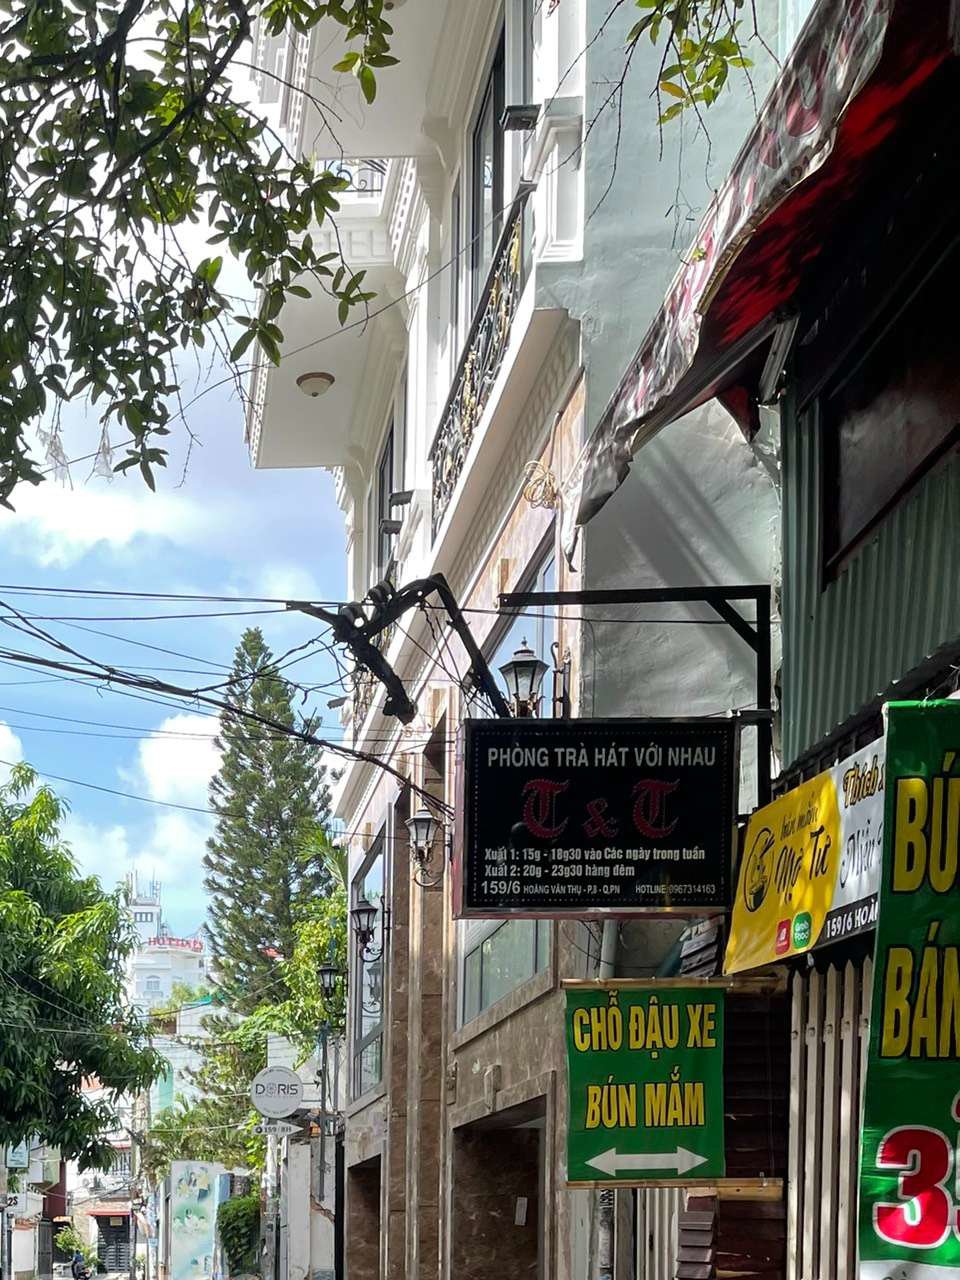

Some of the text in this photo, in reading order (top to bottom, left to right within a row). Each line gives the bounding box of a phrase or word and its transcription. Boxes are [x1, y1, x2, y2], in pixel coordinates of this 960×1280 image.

[487, 742, 716, 768] PHÒNG TRÀ HÁT VỚI NHAU
[582, 798, 619, 838] &
[522, 848, 541, 861] 15g
[551, 848, 582, 861] 18g30
[584, 847, 602, 860] vào
[604, 846, 623, 859] Các
[626, 847, 651, 860] ngày
[653, 848, 680, 860] trong
[682, 845, 705, 860] tuần
[523, 865, 542, 878] 20g
[551, 865, 583, 878] 23g30
[585, 864, 610, 878] hàng
[612, 864, 635, 876] đêm
[481, 880, 520, 894] 159/6
[523, 883, 549, 894] HOÀNG
[827, 912, 853, 938] 159/6
[573, 990, 716, 1059] CHỖ ĐẬU XE
[585, 1065, 705, 1129] BÚN MẮM
